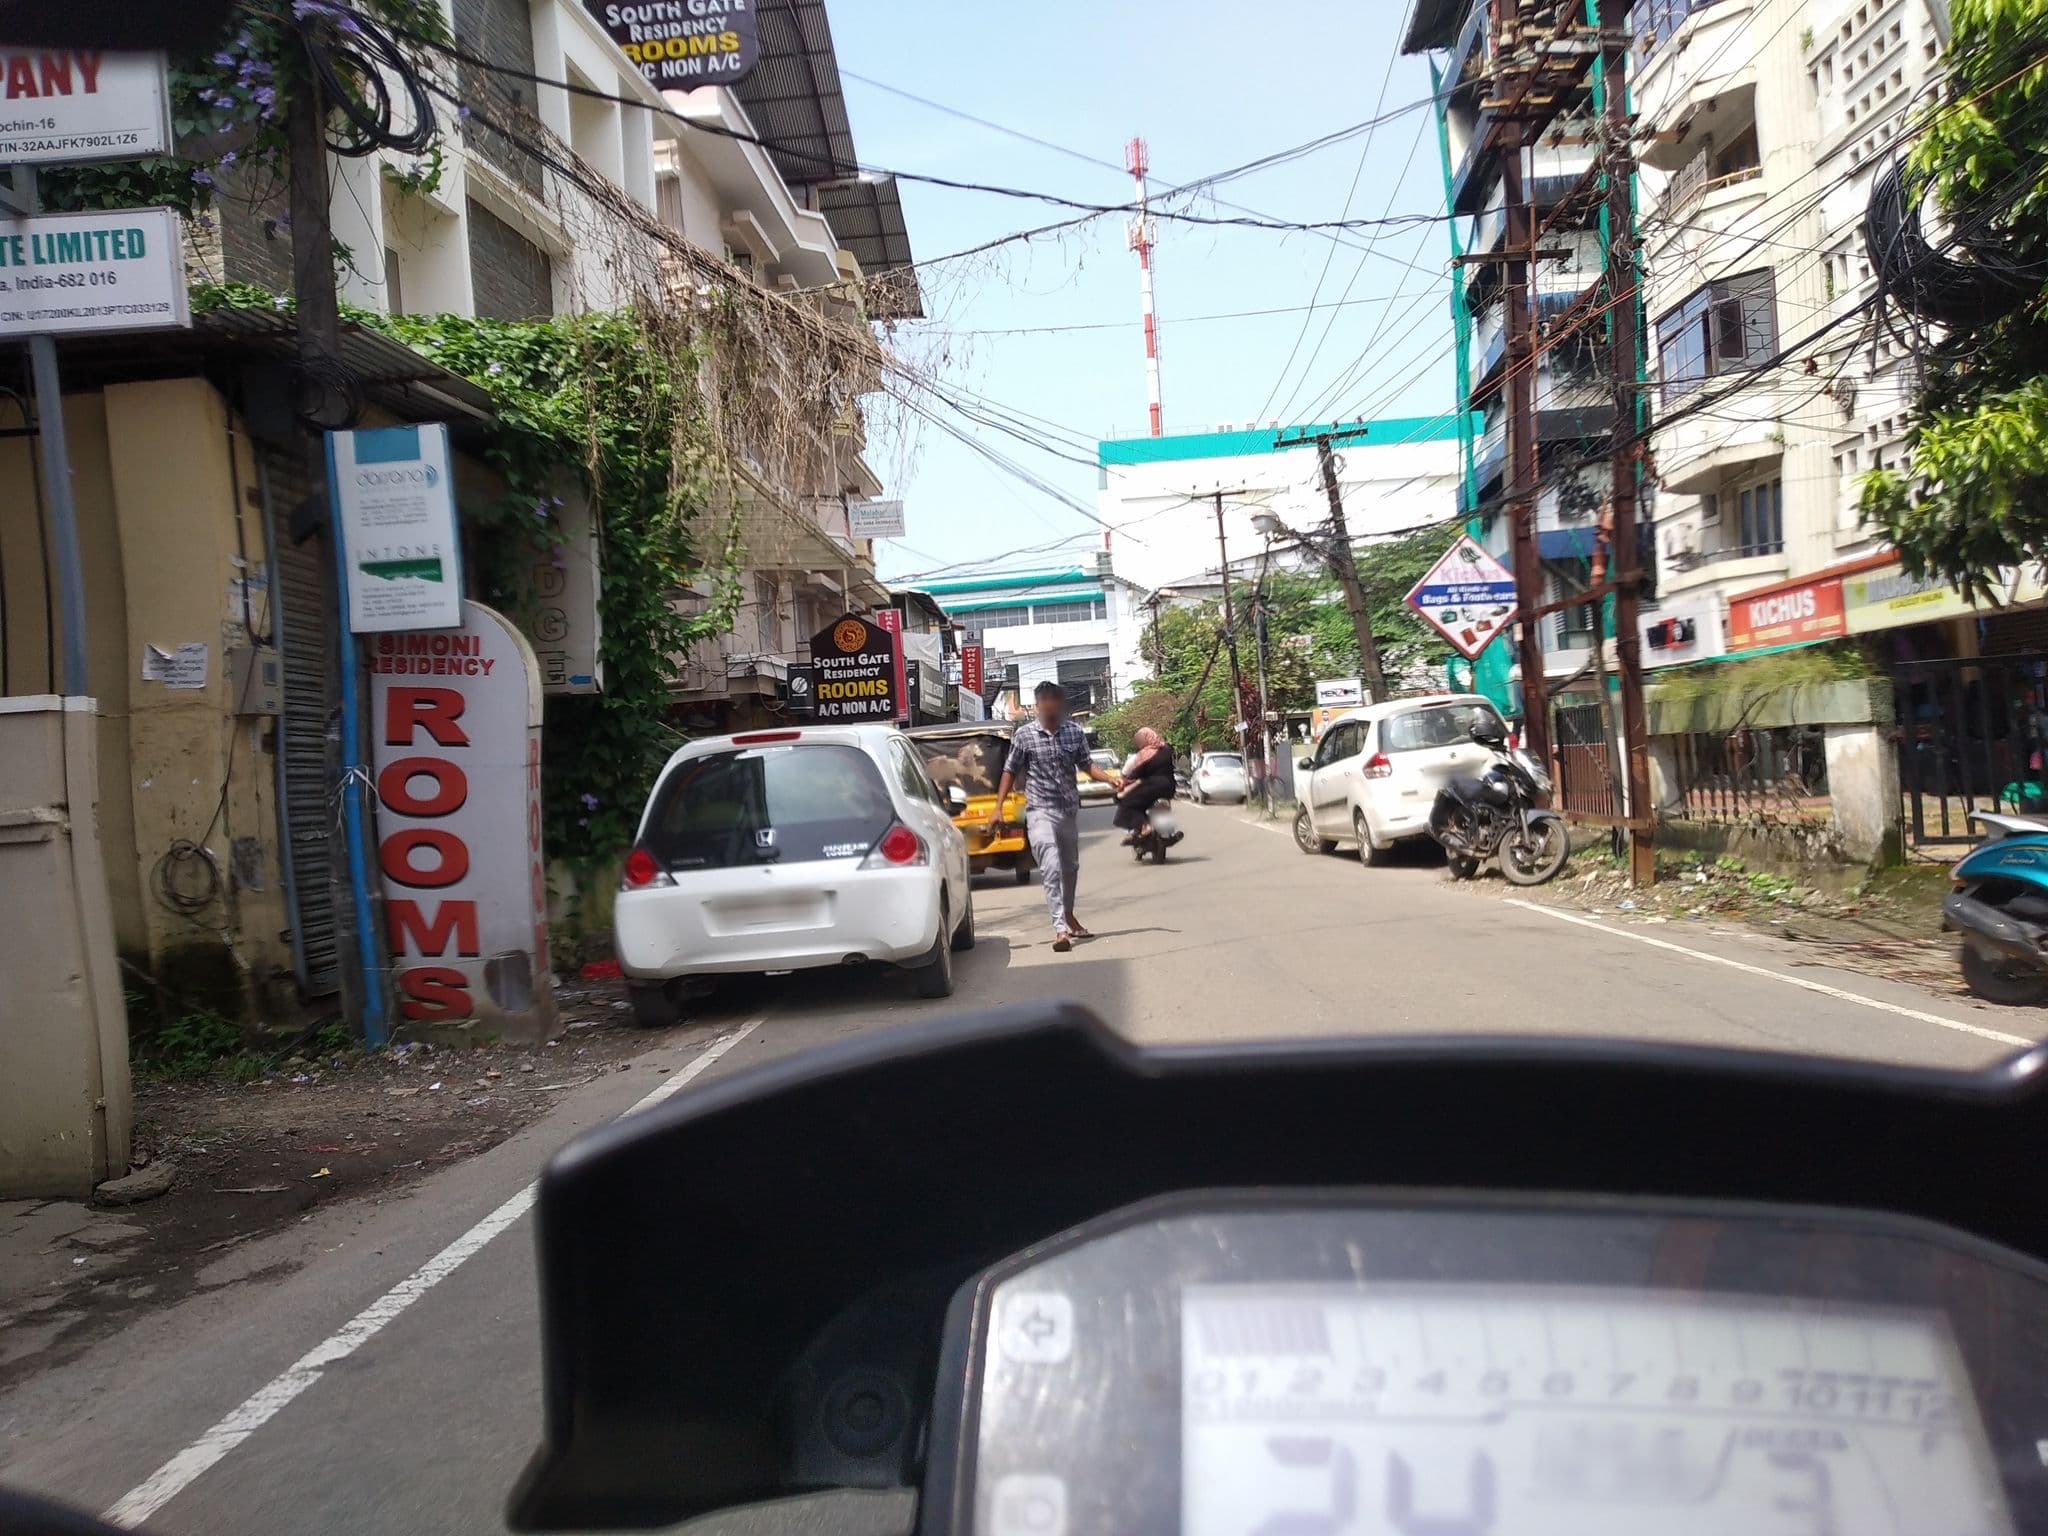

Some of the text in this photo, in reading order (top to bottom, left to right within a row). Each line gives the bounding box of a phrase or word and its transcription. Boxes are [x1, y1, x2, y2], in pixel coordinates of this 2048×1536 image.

[605, 0, 746, 28] SOUTH GATE
[629, 16, 728, 43] RESIDENCY
[0, 50, 104, 100] ANY
[661, 56, 700, 79] NON
[708, 52, 741, 73] A/C
[31, 228, 146, 265] LIMITED
[15, 273, 87, 291] India-682
[89, 271, 117, 286] 016
[1450, 593, 1461, 603] &
[1748, 589, 1816, 628] KICHUS
[378, 634, 480, 657] SIMONI
[368, 657, 495, 676] RESIDENCY
[813, 656, 855, 669] SOUTH
[858, 653, 890, 666] GATE
[823, 667, 881, 680] RESIDENCY
[817, 679, 889, 700] ROOMS
[818, 698, 891, 717] A/C NON A/C
[378, 686, 480, 1021] ROOMS
[1603, 1372, 1638, 1399] 7
